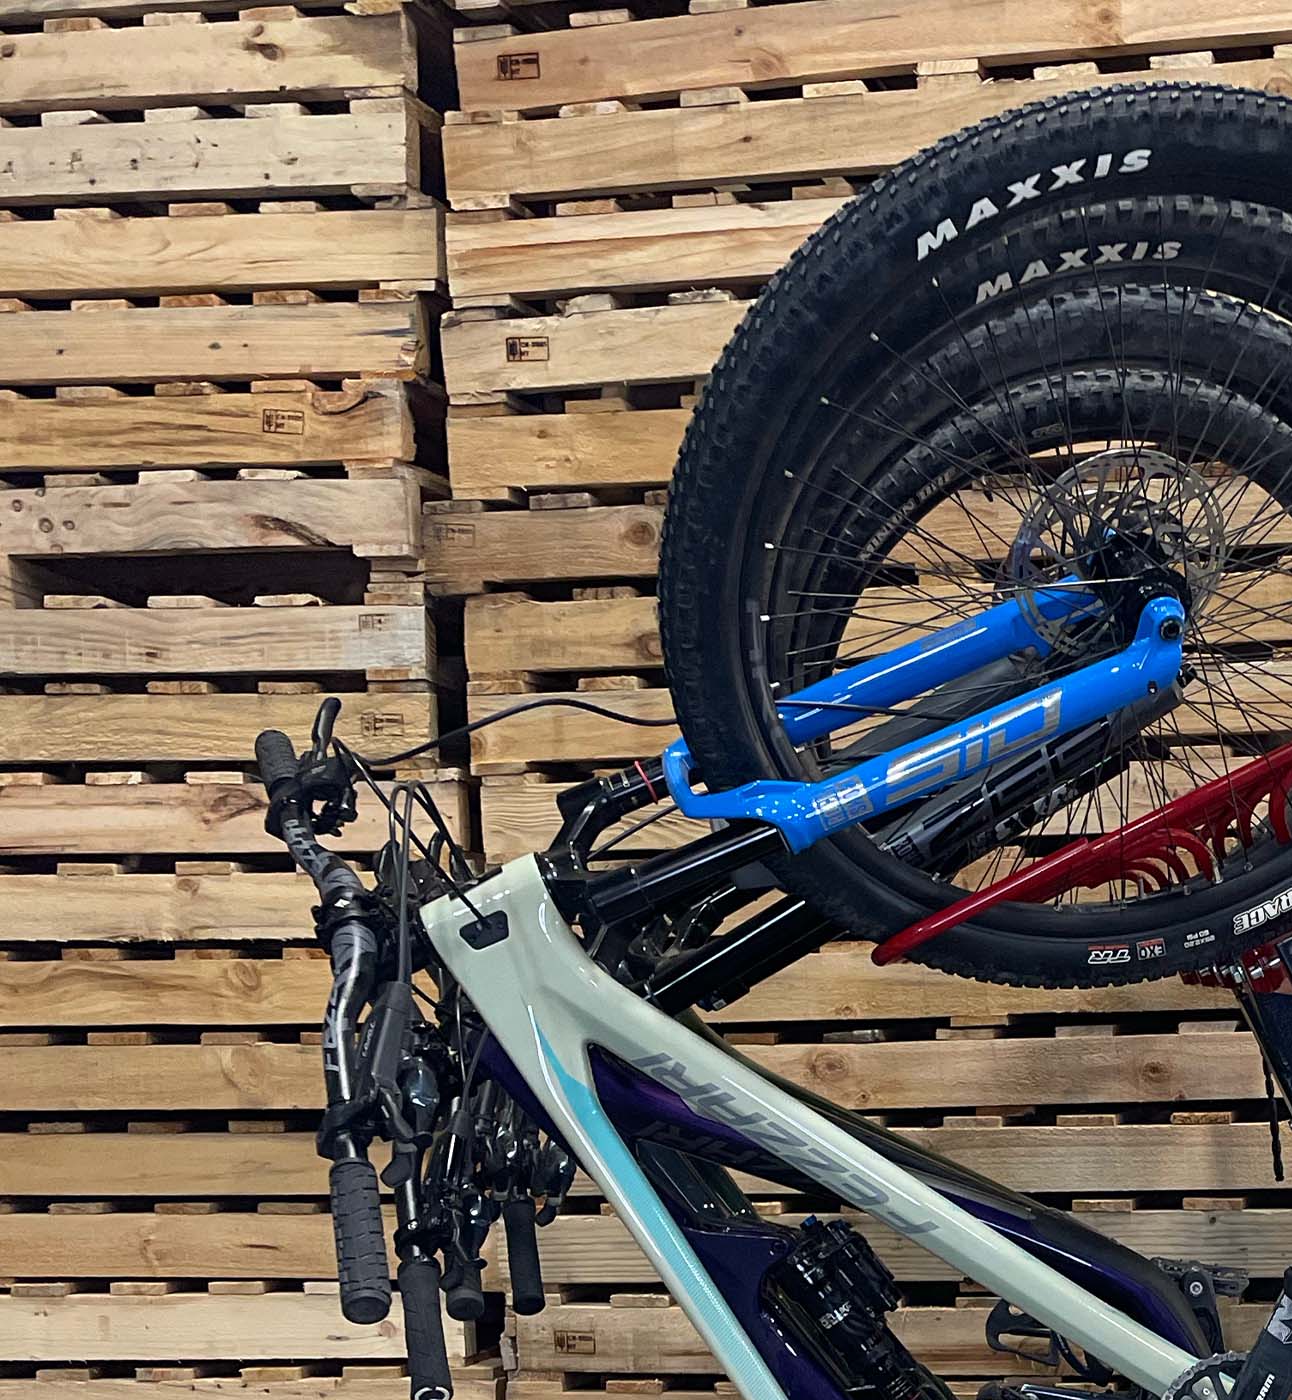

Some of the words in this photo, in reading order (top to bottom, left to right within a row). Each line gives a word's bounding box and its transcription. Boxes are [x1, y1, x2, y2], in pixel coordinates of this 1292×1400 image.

[917, 149, 1152, 262] MAXXIS
[975, 241, 1182, 304] MAXXIS
[1087, 949, 1131, 965] TR
[1139, 943, 1164, 960] EXO
[631, 1052, 940, 1235] FEZZARI
